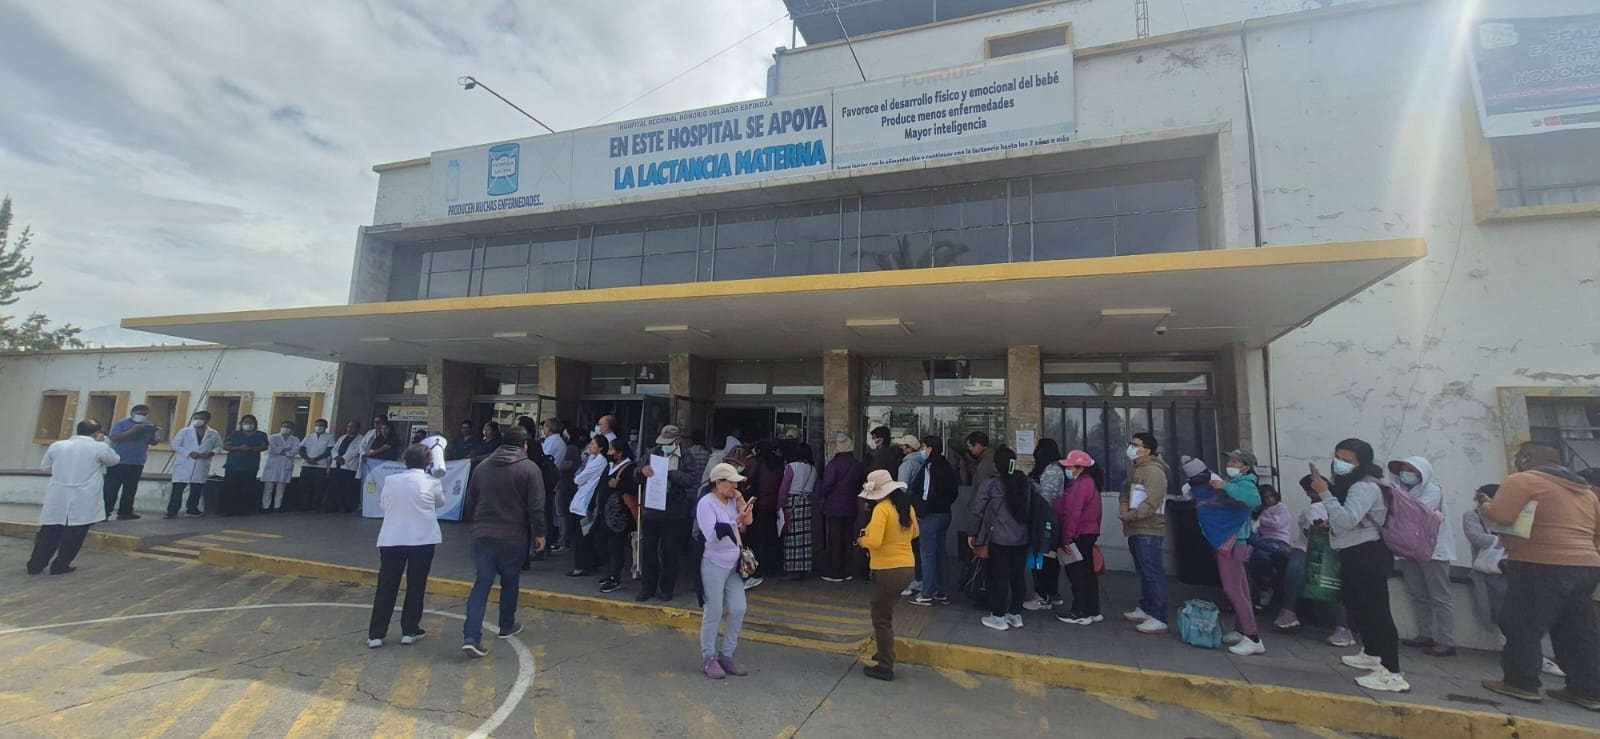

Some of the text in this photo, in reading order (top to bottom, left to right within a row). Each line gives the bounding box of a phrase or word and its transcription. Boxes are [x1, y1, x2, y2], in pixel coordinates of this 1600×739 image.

[841, 70, 1059, 118] Favorece el desarrollo físico y emocional del bebé
[619, 100, 773, 131] HOSPITAL REGIONAL HONORIO DELGADO ESPINOZA
[881, 97, 1015, 127] Produce menos enfermedades
[609, 105, 828, 159] EN ESTE HOSPITAL SE APOYA
[904, 116, 987, 141] Mayor inteligencia
[614, 139, 828, 191] LA LACTANCIA MATERNA
[475, 199, 497, 214] MUCHAS
